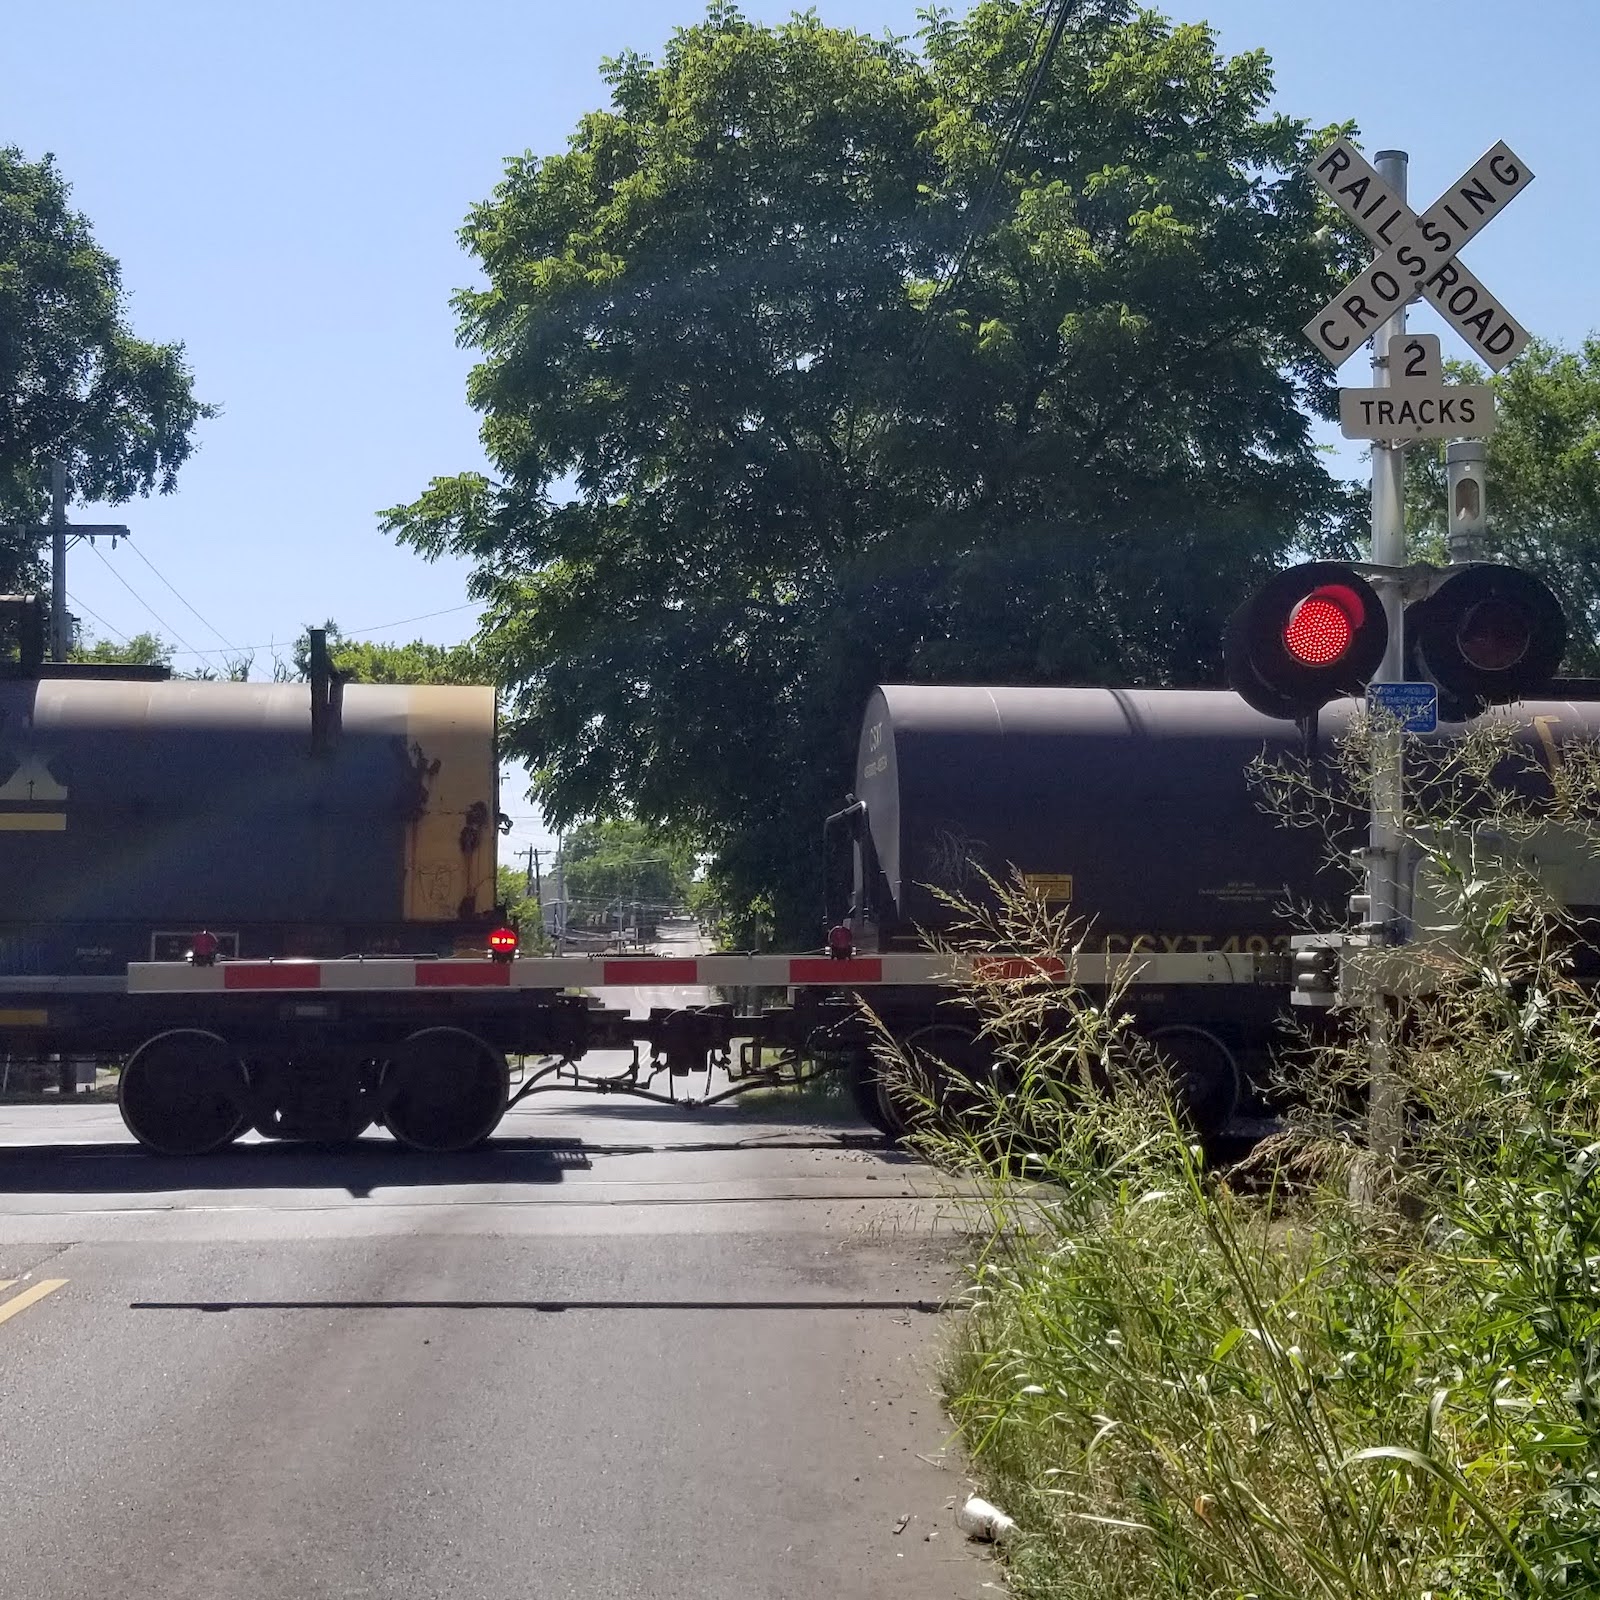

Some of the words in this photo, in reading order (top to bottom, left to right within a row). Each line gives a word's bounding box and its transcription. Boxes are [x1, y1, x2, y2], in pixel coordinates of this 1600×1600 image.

[1317, 147, 1402, 246] RAIL
[1426, 263, 1515, 356] ROAD
[1319, 155, 1520, 351] CROSSING
[1360, 398, 1476, 425] TRACKS
[1404, 343, 1427, 377] 2
